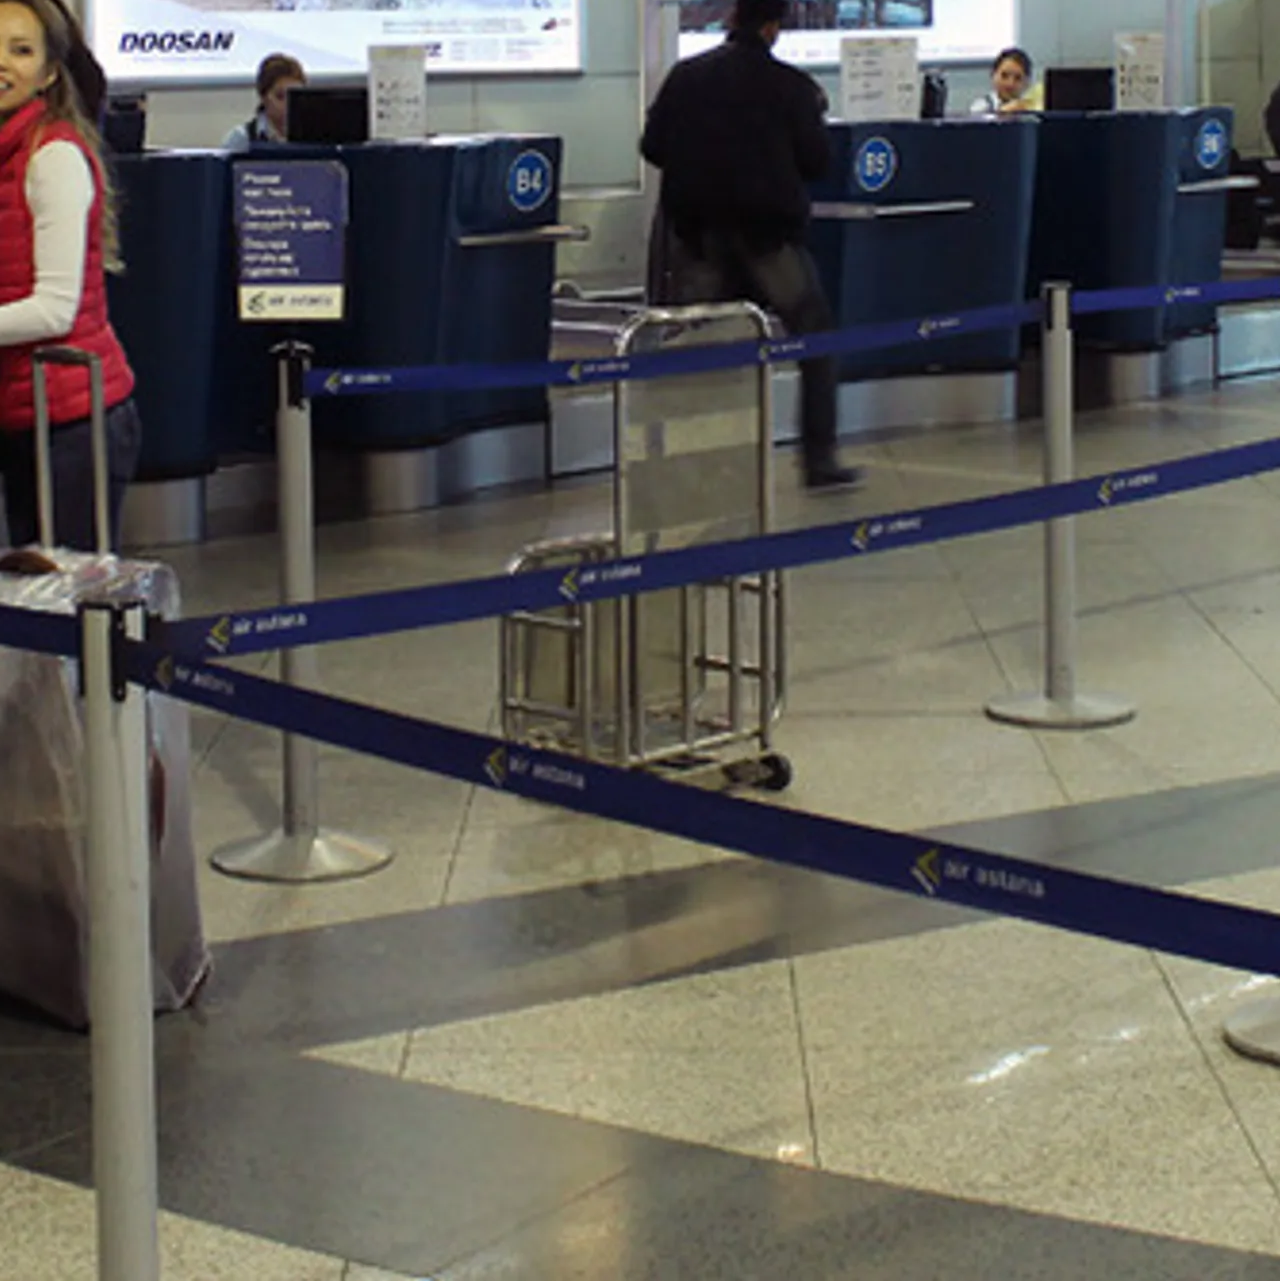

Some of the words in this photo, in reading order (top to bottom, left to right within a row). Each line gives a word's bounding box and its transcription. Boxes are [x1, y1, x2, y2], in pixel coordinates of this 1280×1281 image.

[118, 30, 235, 53] DOOSAN
[865, 151, 887, 176] B5
[515, 167, 542, 193] B4
[942, 856, 970, 881] air
[976, 862, 1046, 900] astana
